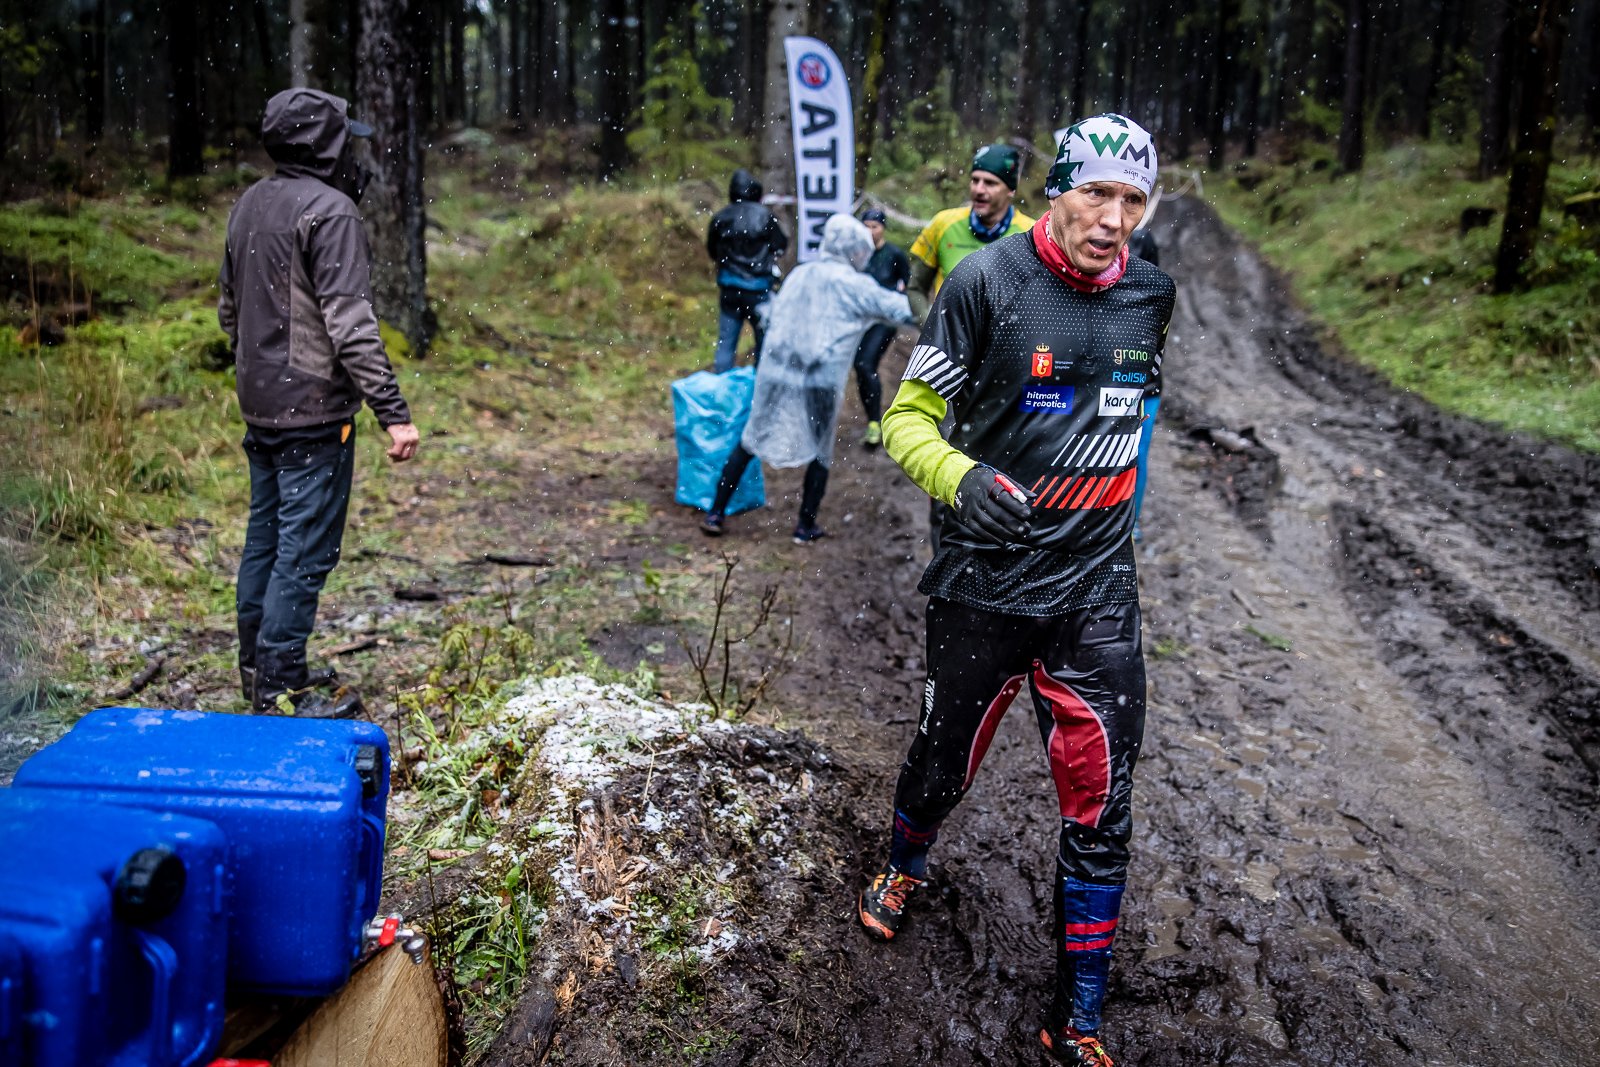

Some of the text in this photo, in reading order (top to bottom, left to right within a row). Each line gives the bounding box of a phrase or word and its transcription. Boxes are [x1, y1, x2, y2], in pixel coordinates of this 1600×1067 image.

[1088, 132, 1150, 170] WM
[1113, 348, 1148, 365] grano
[1026, 391, 1060, 400] hitmark
[1032, 399, 1067, 409] robotics
